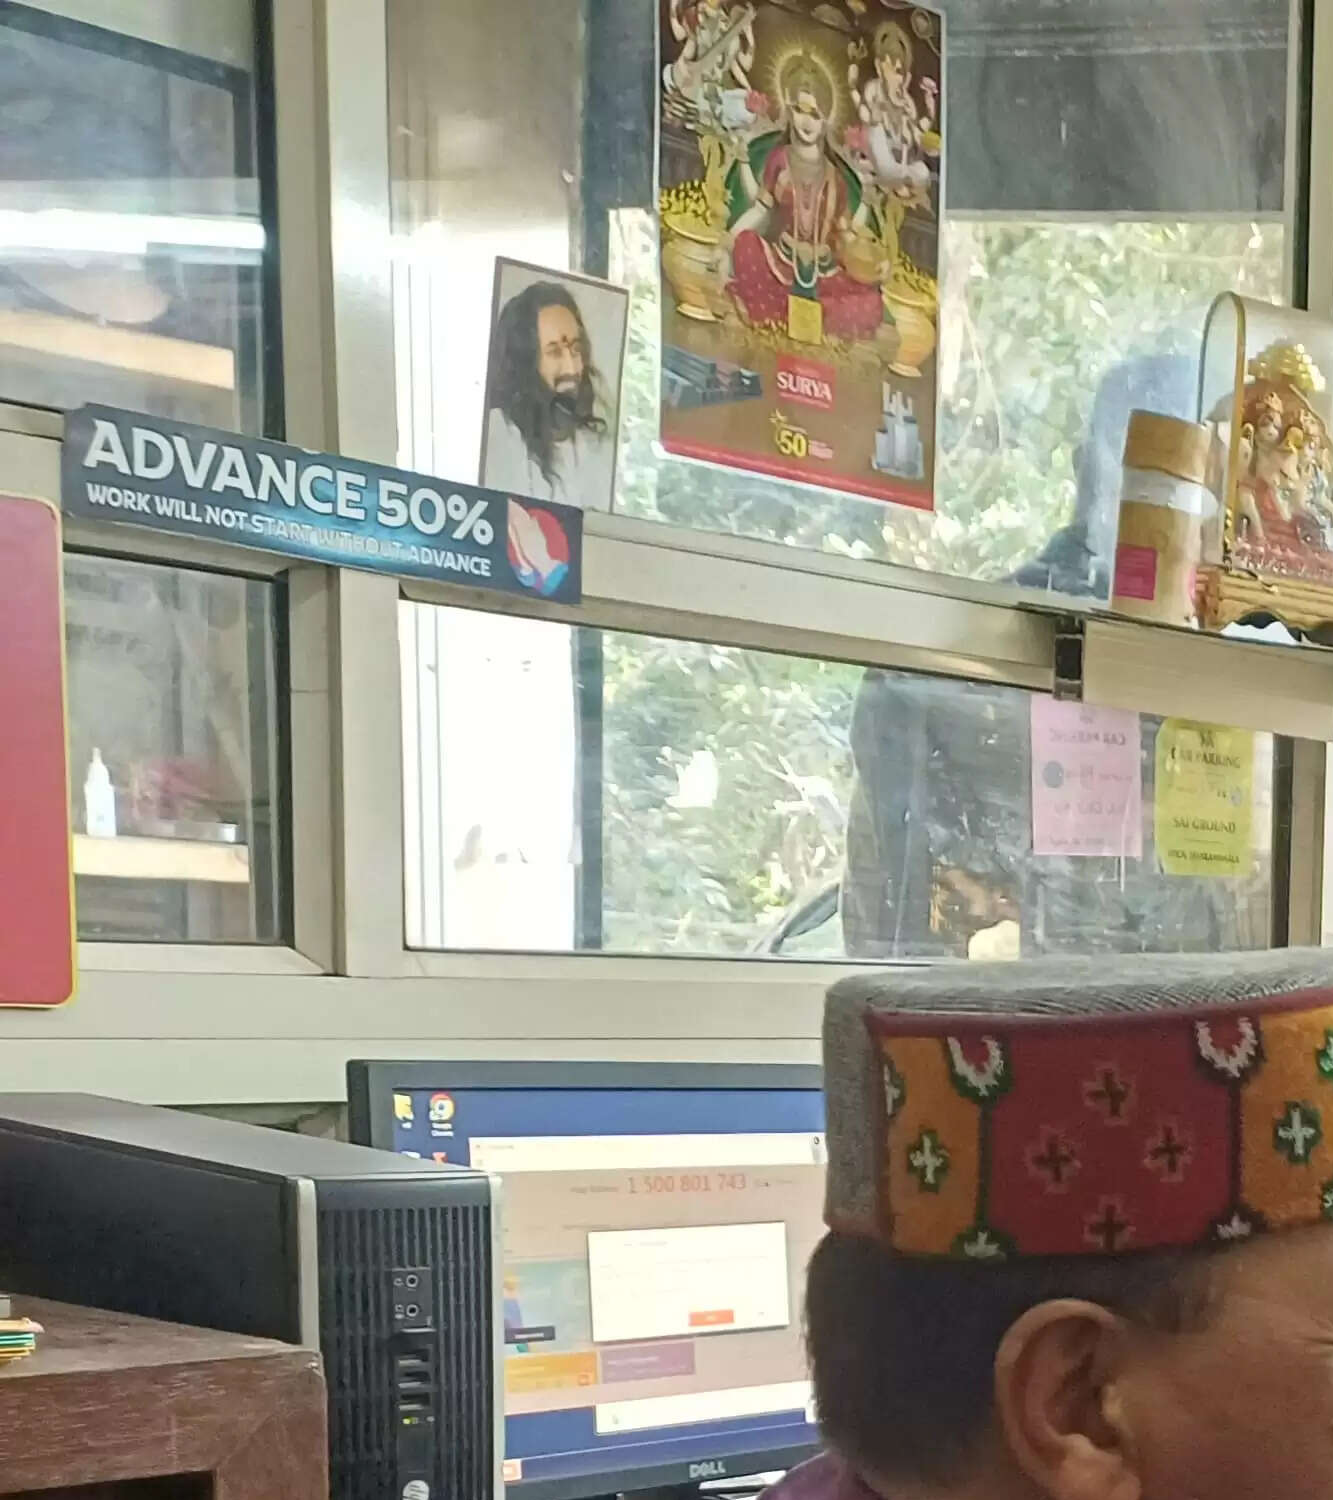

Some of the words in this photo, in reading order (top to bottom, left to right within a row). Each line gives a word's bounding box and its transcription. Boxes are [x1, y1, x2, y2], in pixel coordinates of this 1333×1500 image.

[776, 371, 832, 402] SURYA
[779, 429, 807, 457] 50
[83, 418, 367, 521] ADVANCE
[376, 479, 495, 546] 50%
[86, 481, 152, 515] WORK
[153, 494, 203, 524] WILL
[204, 503, 248, 530] NOT
[250, 513, 314, 545] START
[316, 527, 403, 562] WITHOUT
[404, 545, 493, 578] ADVANCE
[688, 1460, 727, 1479] DELL
